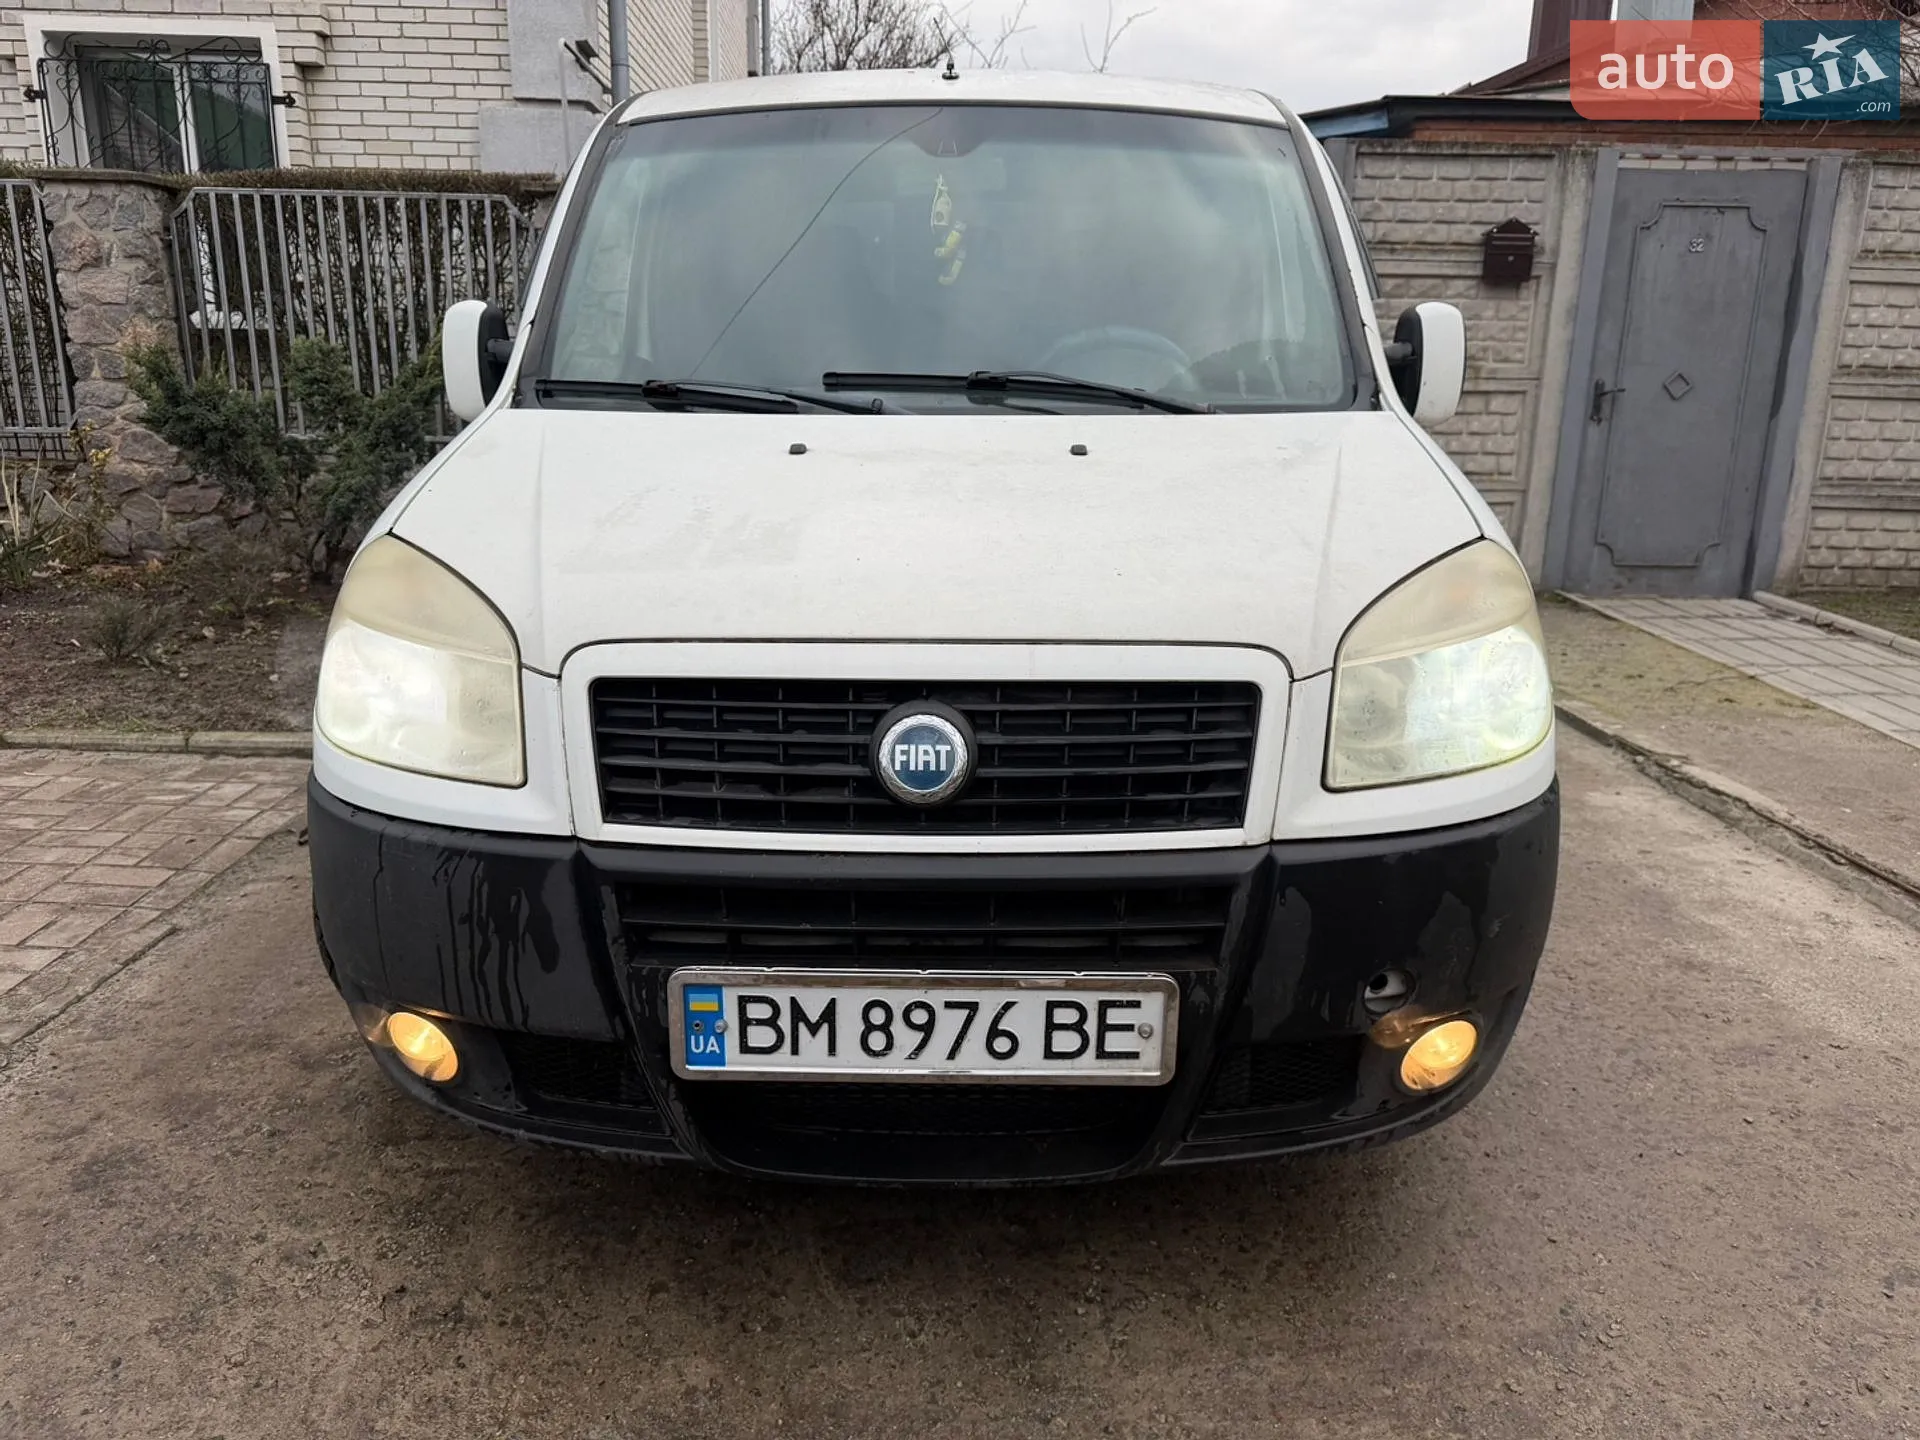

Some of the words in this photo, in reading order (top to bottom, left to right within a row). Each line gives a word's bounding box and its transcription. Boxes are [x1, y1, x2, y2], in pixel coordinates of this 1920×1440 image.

[894, 743, 951, 771] FIAT
[737, 994, 837, 1057] BM
[859, 999, 1020, 1061] 8976
[1043, 999, 1143, 1061] BE
[690, 1035, 720, 1054] UA
